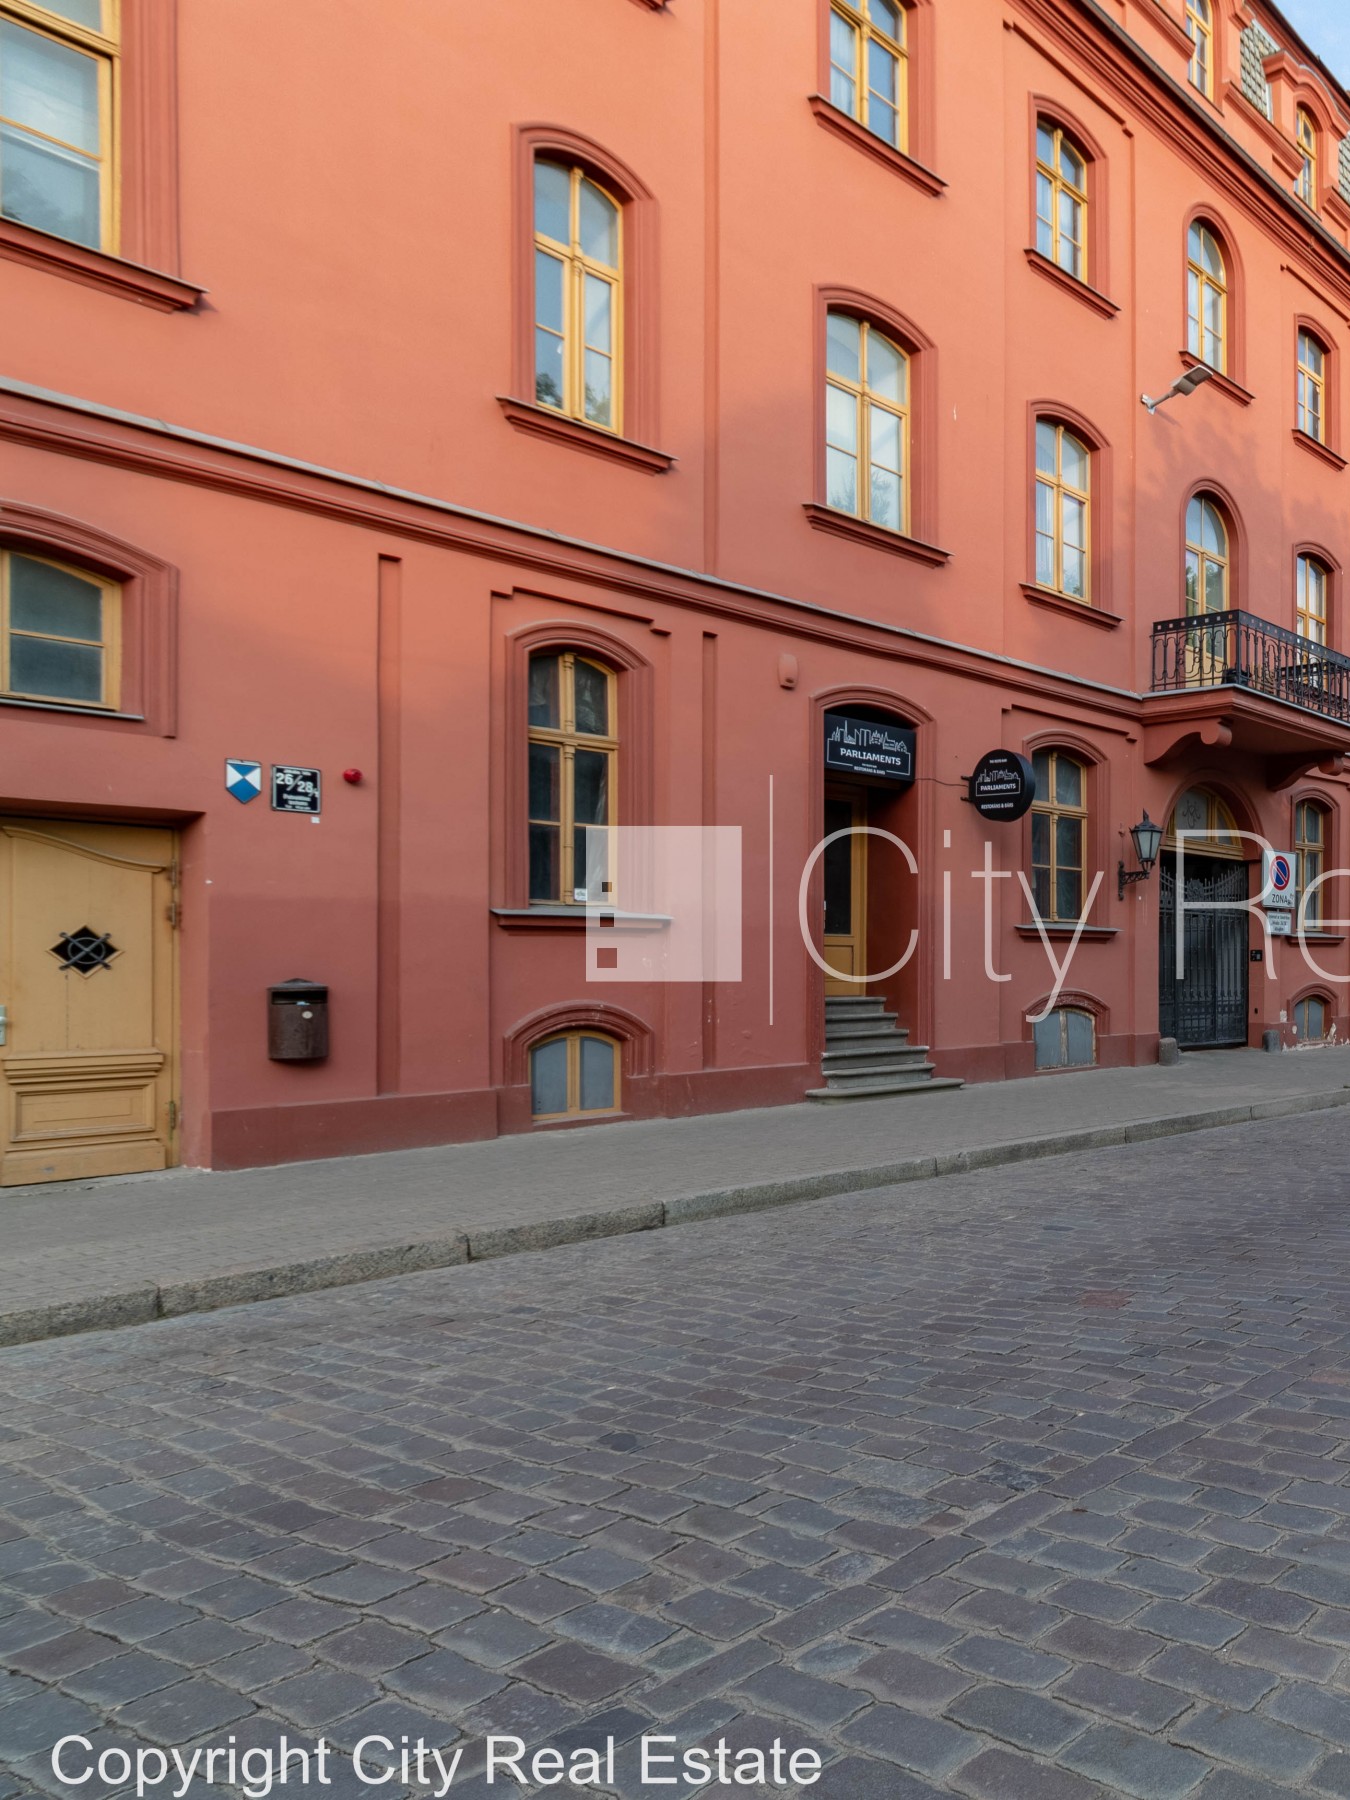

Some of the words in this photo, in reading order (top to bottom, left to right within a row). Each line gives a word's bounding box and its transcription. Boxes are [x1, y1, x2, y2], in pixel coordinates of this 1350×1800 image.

[840, 748, 902, 765] PARLIAMENTS
[980, 783, 1016, 791] PARLIAMENTS
[1272, 894, 1287, 903] ZONA
